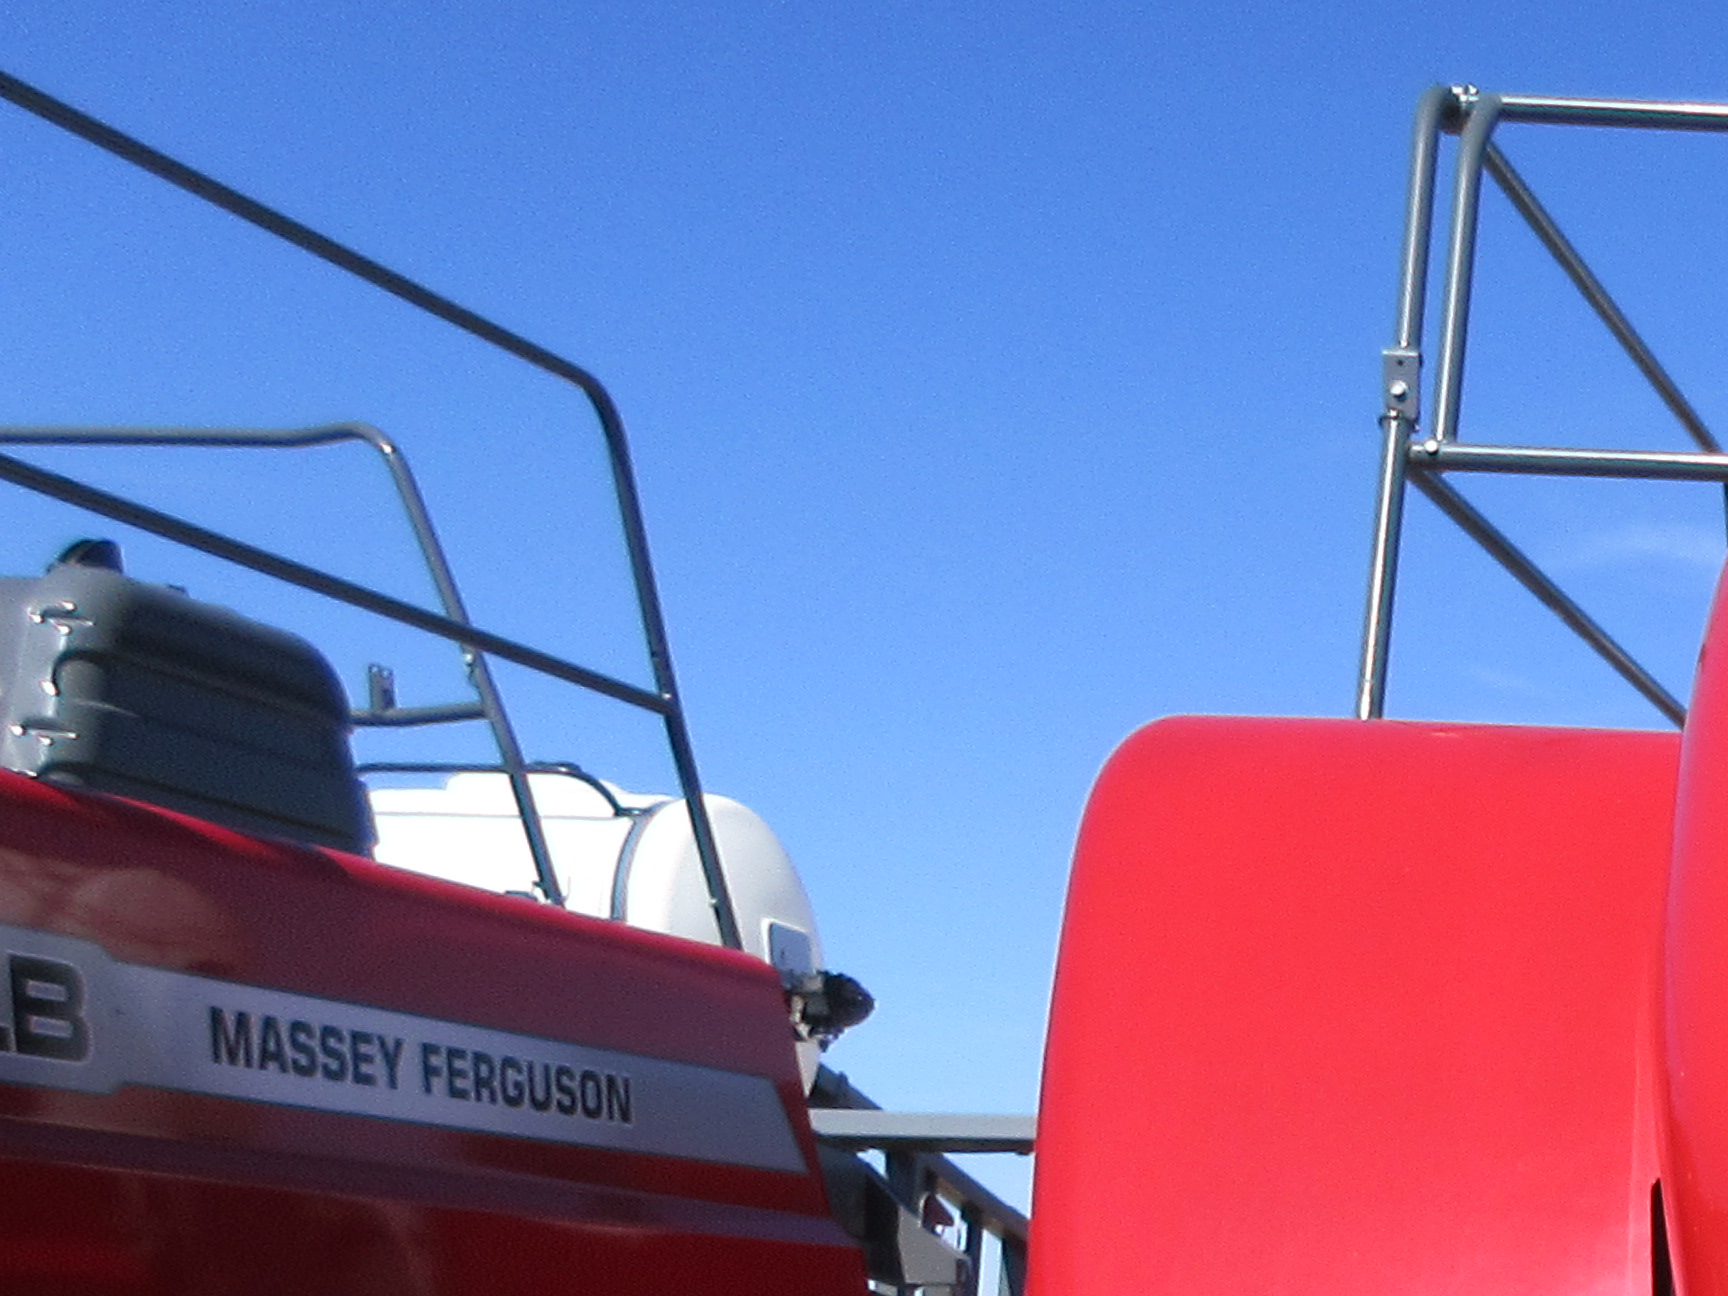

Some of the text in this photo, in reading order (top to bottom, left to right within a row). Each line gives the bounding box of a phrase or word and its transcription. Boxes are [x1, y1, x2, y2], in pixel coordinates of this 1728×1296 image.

[0, 951, 91, 1063] B
[209, 1006, 635, 1126] MASSEY FERGUSON
